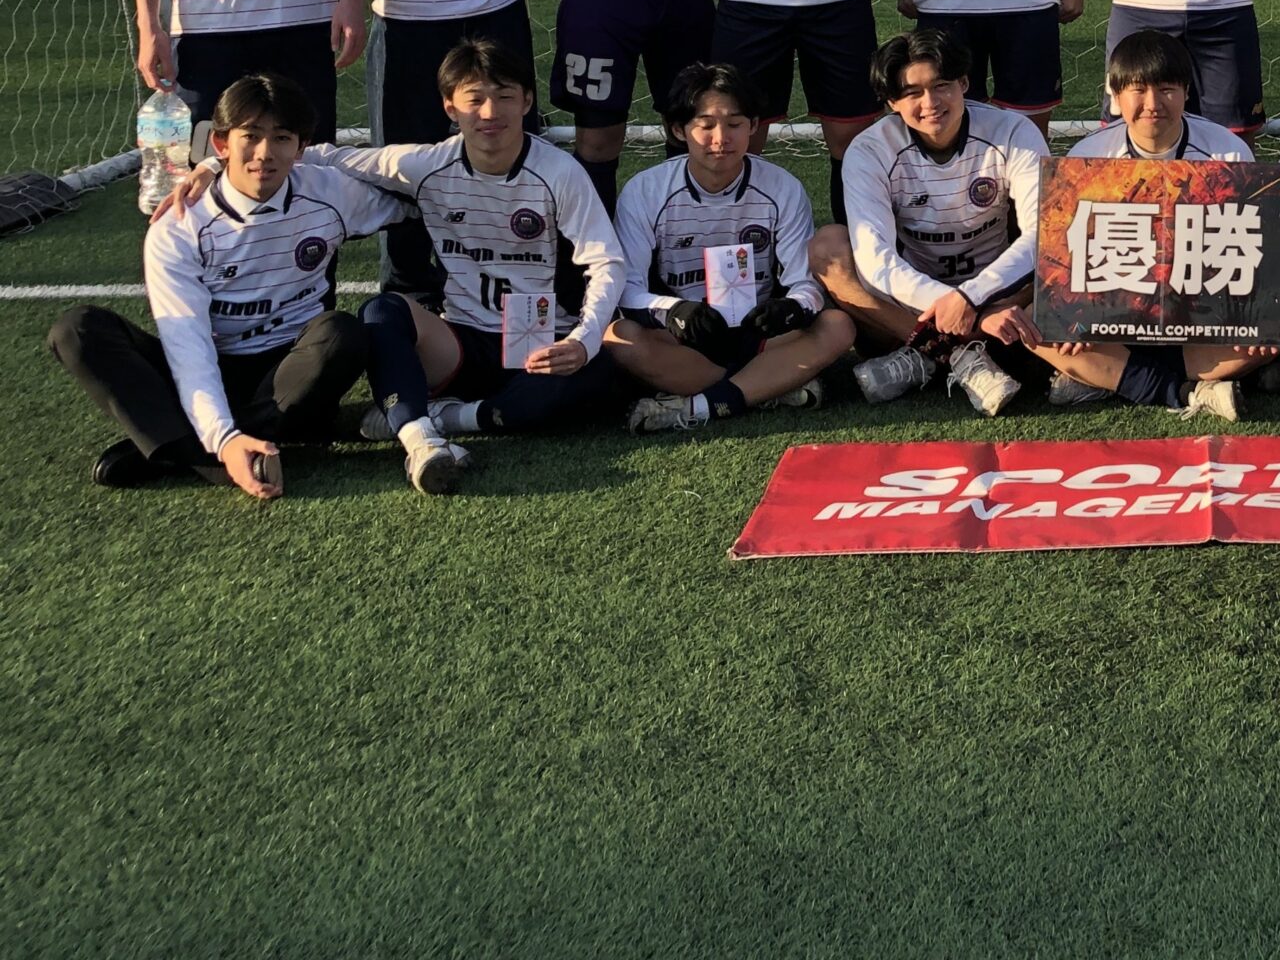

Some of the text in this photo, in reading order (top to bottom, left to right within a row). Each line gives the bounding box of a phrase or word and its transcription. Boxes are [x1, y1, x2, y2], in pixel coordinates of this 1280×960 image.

[565, 52, 614, 101] 25
[938, 248, 975, 279] 35
[1067, 200, 1264, 296] 優勝
[1091, 323, 1259, 338] FOOTBALL COMPETITION
